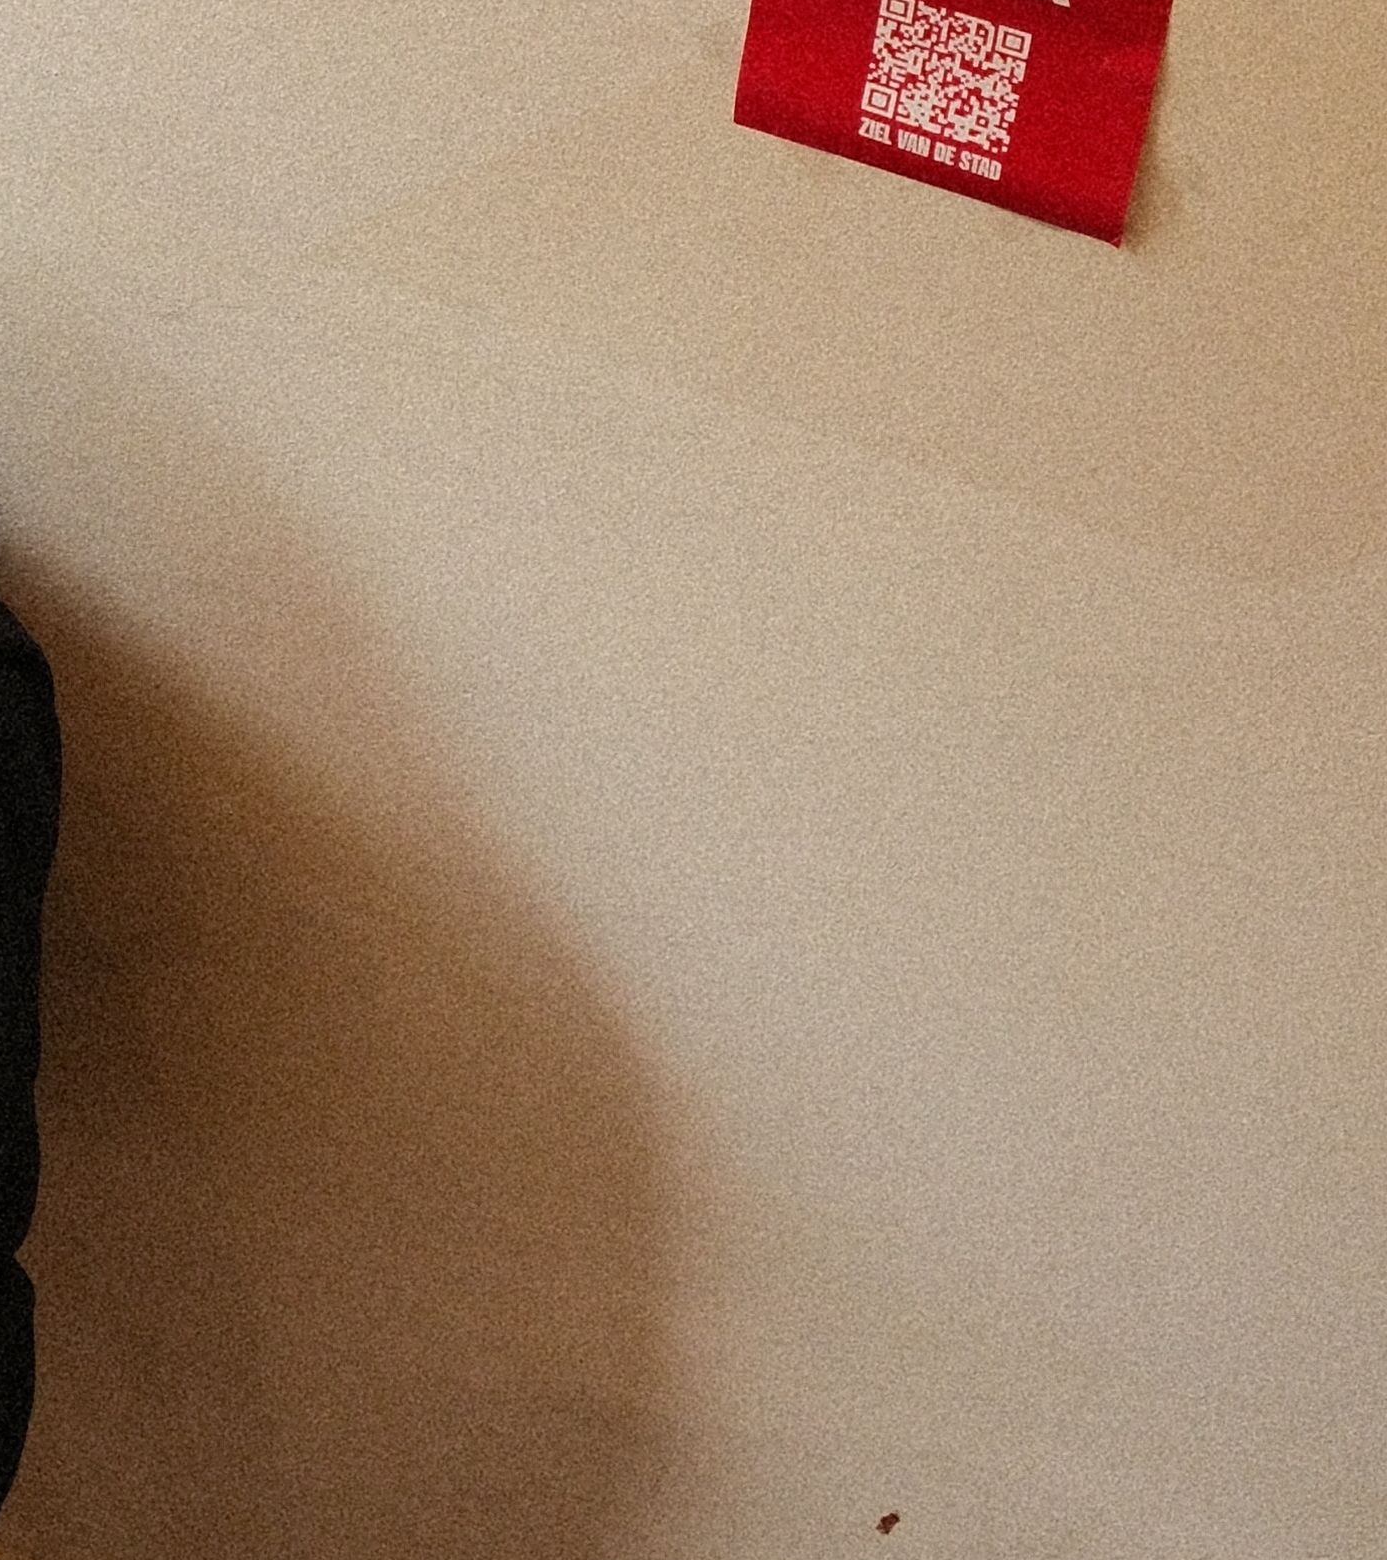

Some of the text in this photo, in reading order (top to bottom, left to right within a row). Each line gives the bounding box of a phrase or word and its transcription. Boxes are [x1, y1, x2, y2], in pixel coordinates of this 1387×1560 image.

[858, 116, 1002, 181] ZIEL VAN DE STAD
